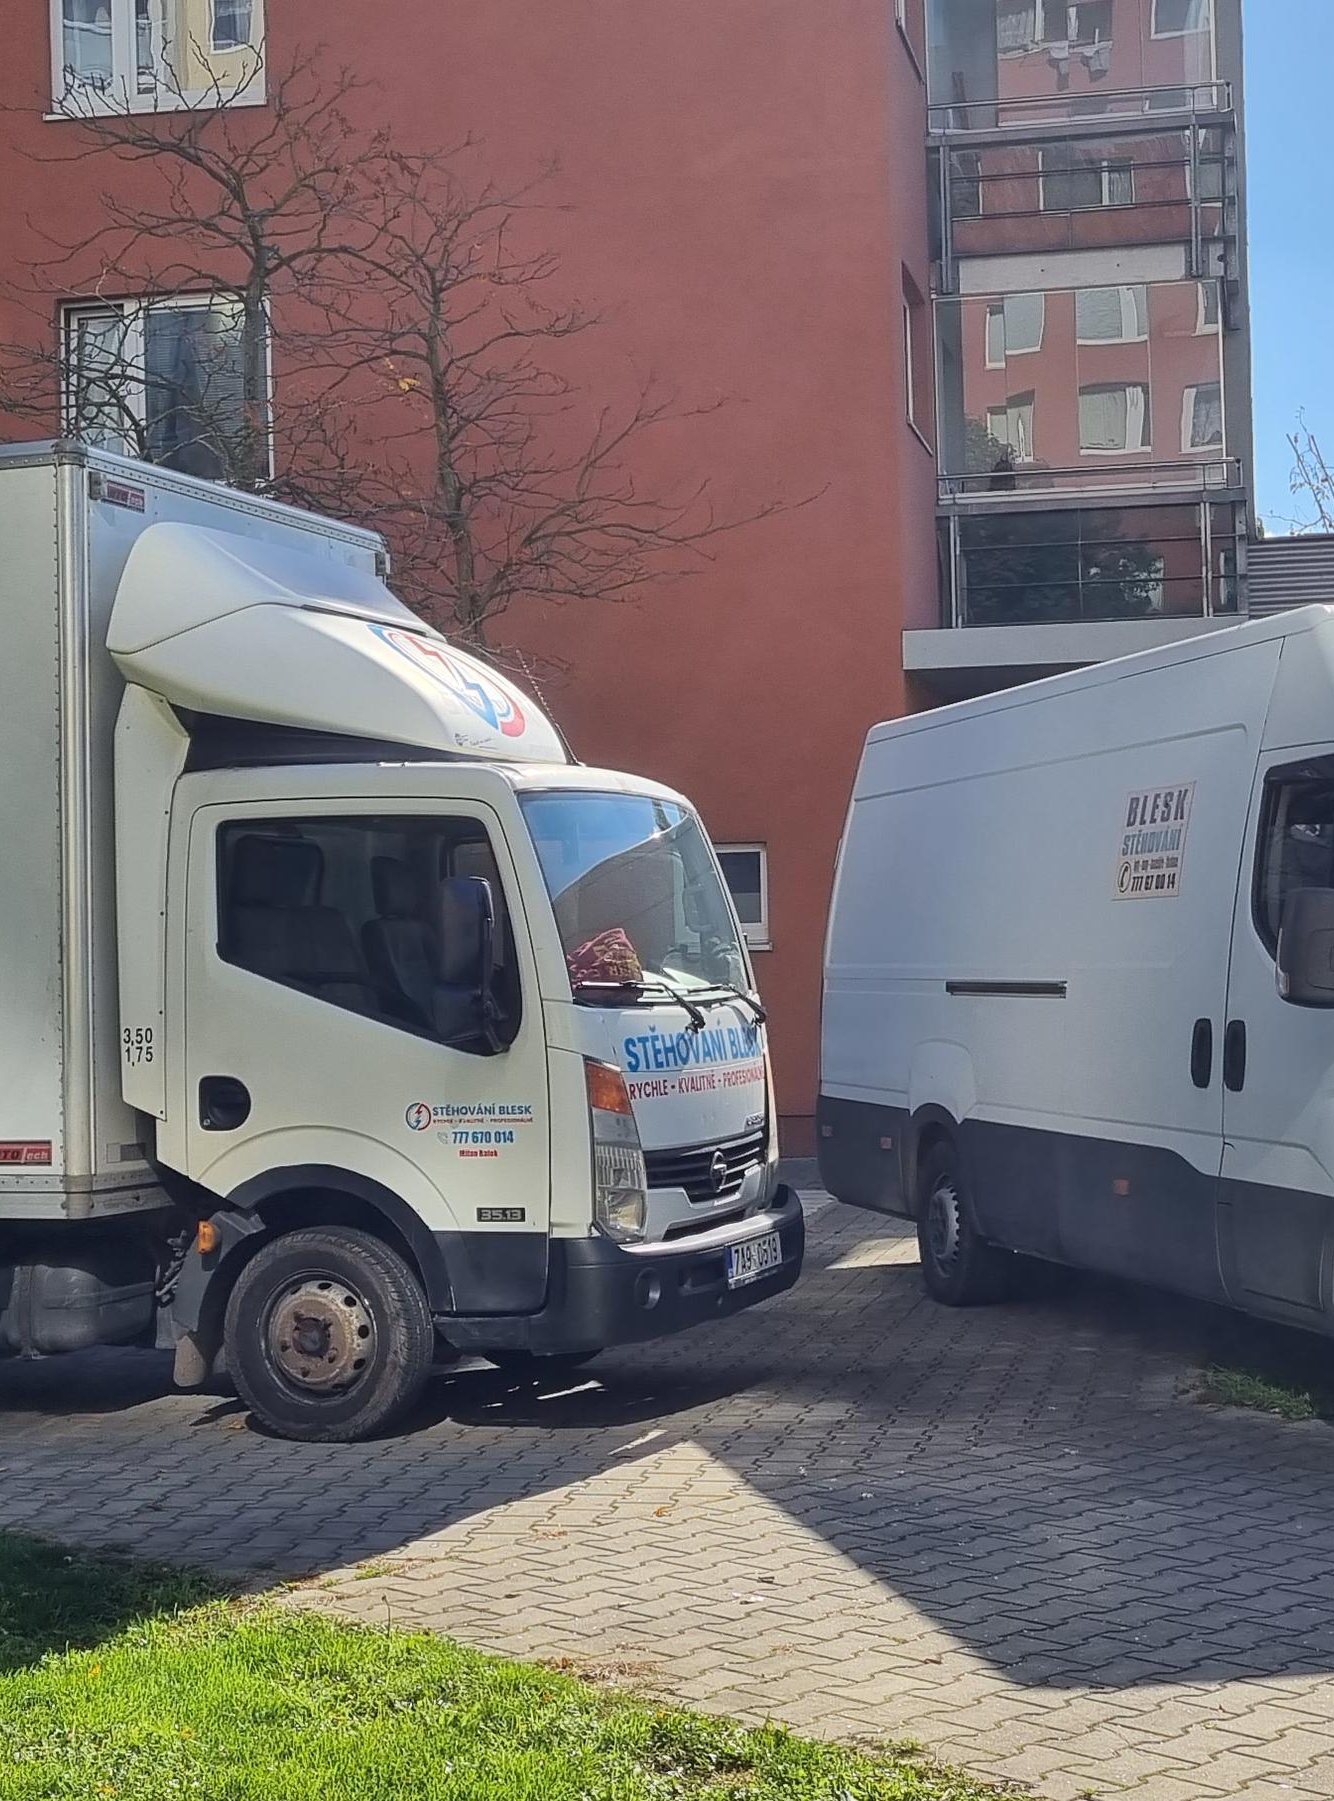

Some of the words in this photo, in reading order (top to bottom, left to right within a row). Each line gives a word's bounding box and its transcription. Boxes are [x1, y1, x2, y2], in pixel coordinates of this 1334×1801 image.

[1126, 789, 1188, 827] BLESK
[623, 1018, 727, 1073] STĚHOVÁNÍ
[629, 1079, 669, 1101] RYCHLE
[678, 1069, 716, 1094] KVALITNĚ
[432, 1103, 496, 1116] STĚHOVÁNÍ
[498, 1105, 532, 1116] BLESK
[452, 1131, 470, 1144] 777
[471, 1131, 492, 1144] 670
[494, 1130, 515, 1144] 014
[480, 1208, 522, 1221] 35.13
